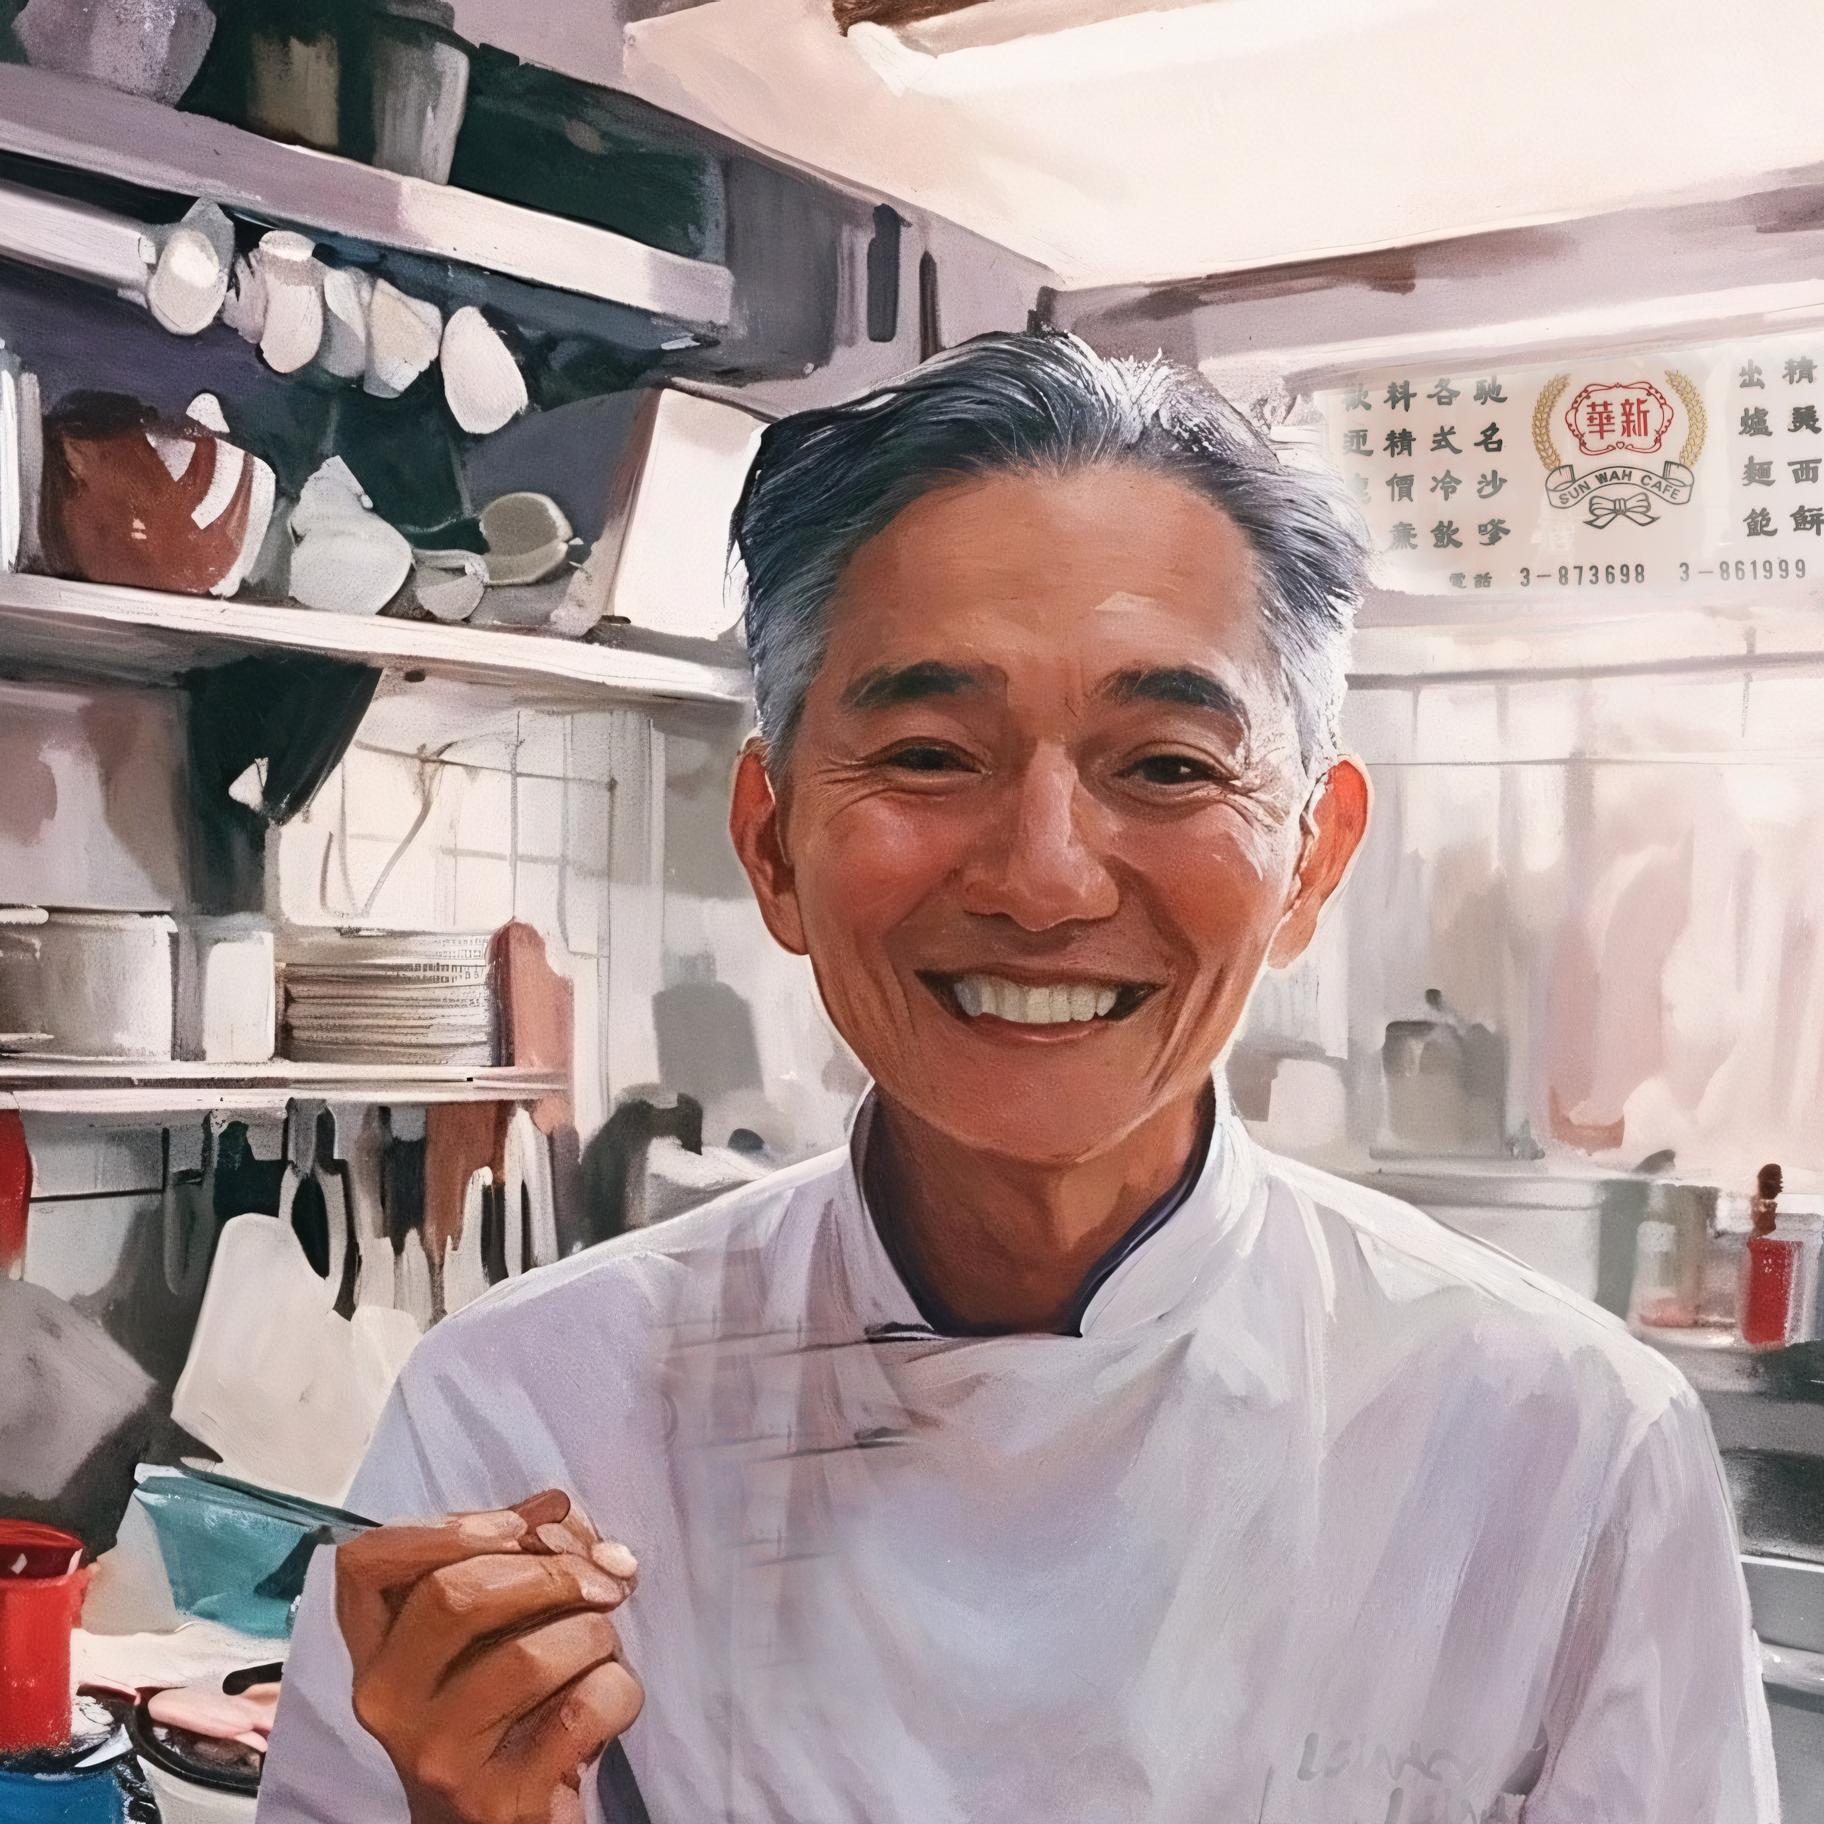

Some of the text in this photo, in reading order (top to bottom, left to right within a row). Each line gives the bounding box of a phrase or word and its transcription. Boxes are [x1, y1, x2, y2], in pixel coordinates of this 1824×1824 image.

[1426, 378, 1463, 548] 各式冷飲
[1559, 470, 1681, 505] SUN WAH CAFE
[1449, 559, 1807, 589] 電話 3-873698 3-861999
